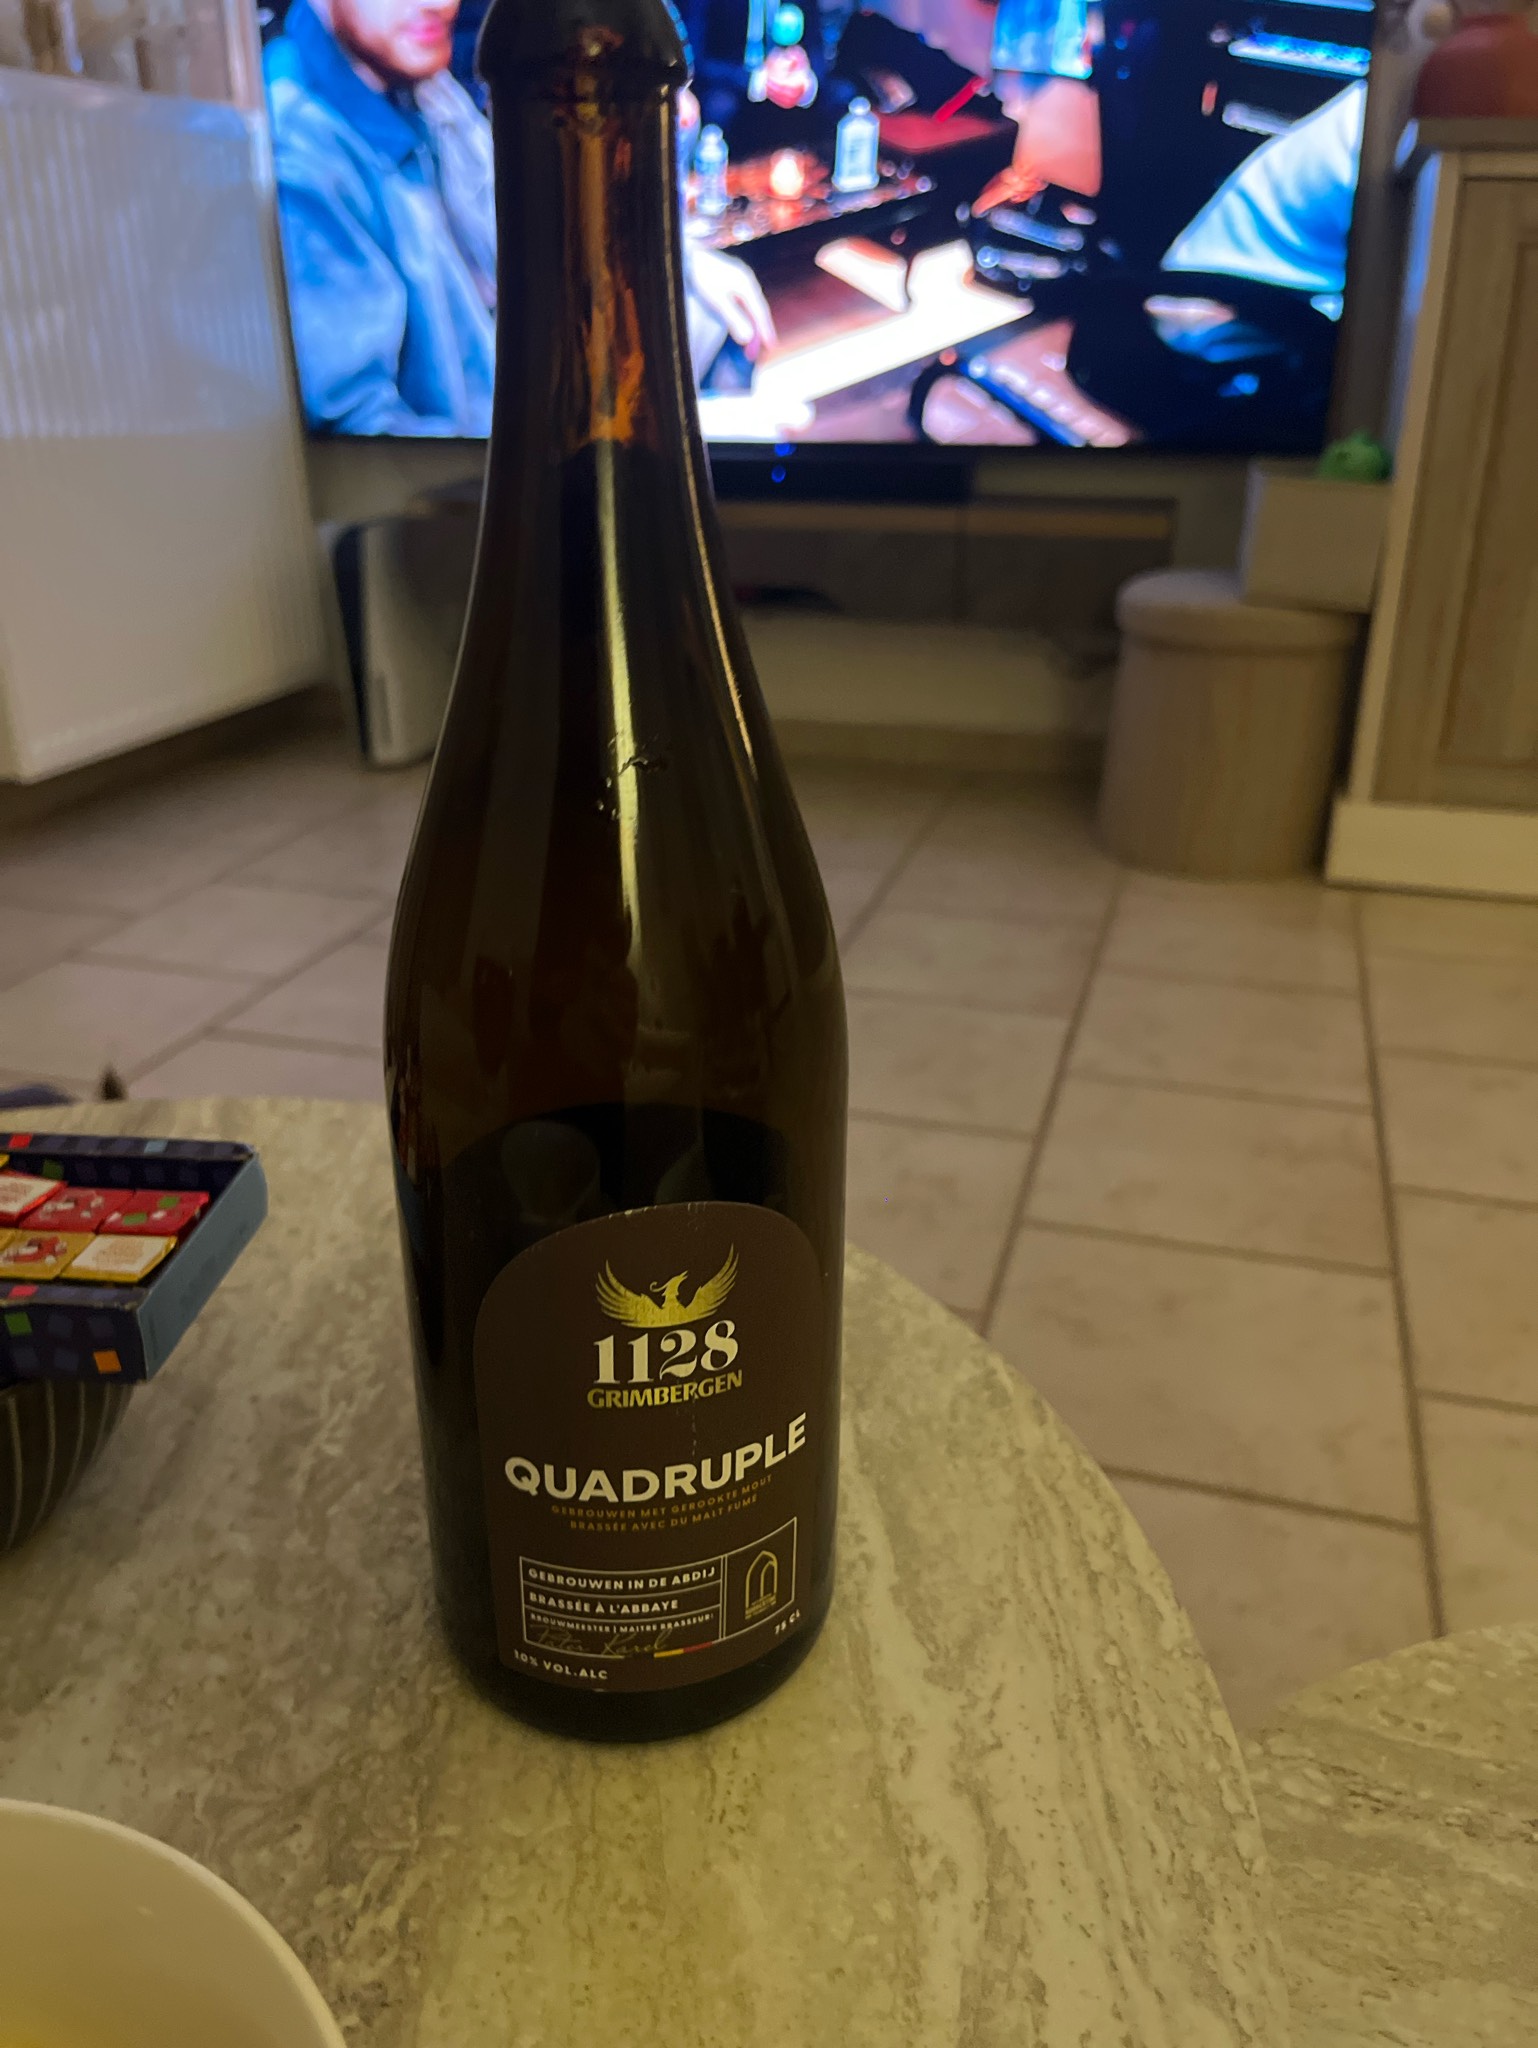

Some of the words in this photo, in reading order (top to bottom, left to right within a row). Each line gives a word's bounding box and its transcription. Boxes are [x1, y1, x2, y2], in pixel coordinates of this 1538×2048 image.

[594, 1320, 738, 1385] 1128
[587, 1369, 742, 1409] GRIMBERGEN
[504, 1412, 807, 1503] QUADRUPLE
[551, 1504, 636, 1518] GEBROUWEN
[641, 1507, 665, 1518] MET
[671, 1490, 738, 1513] GEROOKTE
[741, 1474, 773, 1494] MOUT
[632, 1519, 666, 1531] AVEC
[671, 1515, 688, 1527] DU
[528, 1568, 623, 1590] GEBROUWEN
[628, 1578, 644, 1589] IN
[649, 1577, 667, 1588] DE
[671, 1566, 715, 1586] ABDIJ
[529, 1592, 591, 1612] BRASSÉE
[595, 1600, 605, 1613] À
[610, 1599, 679, 1614] L'ABBAYE
[775, 1620, 787, 1635] 75
[513, 1648, 539, 1667] 10%
